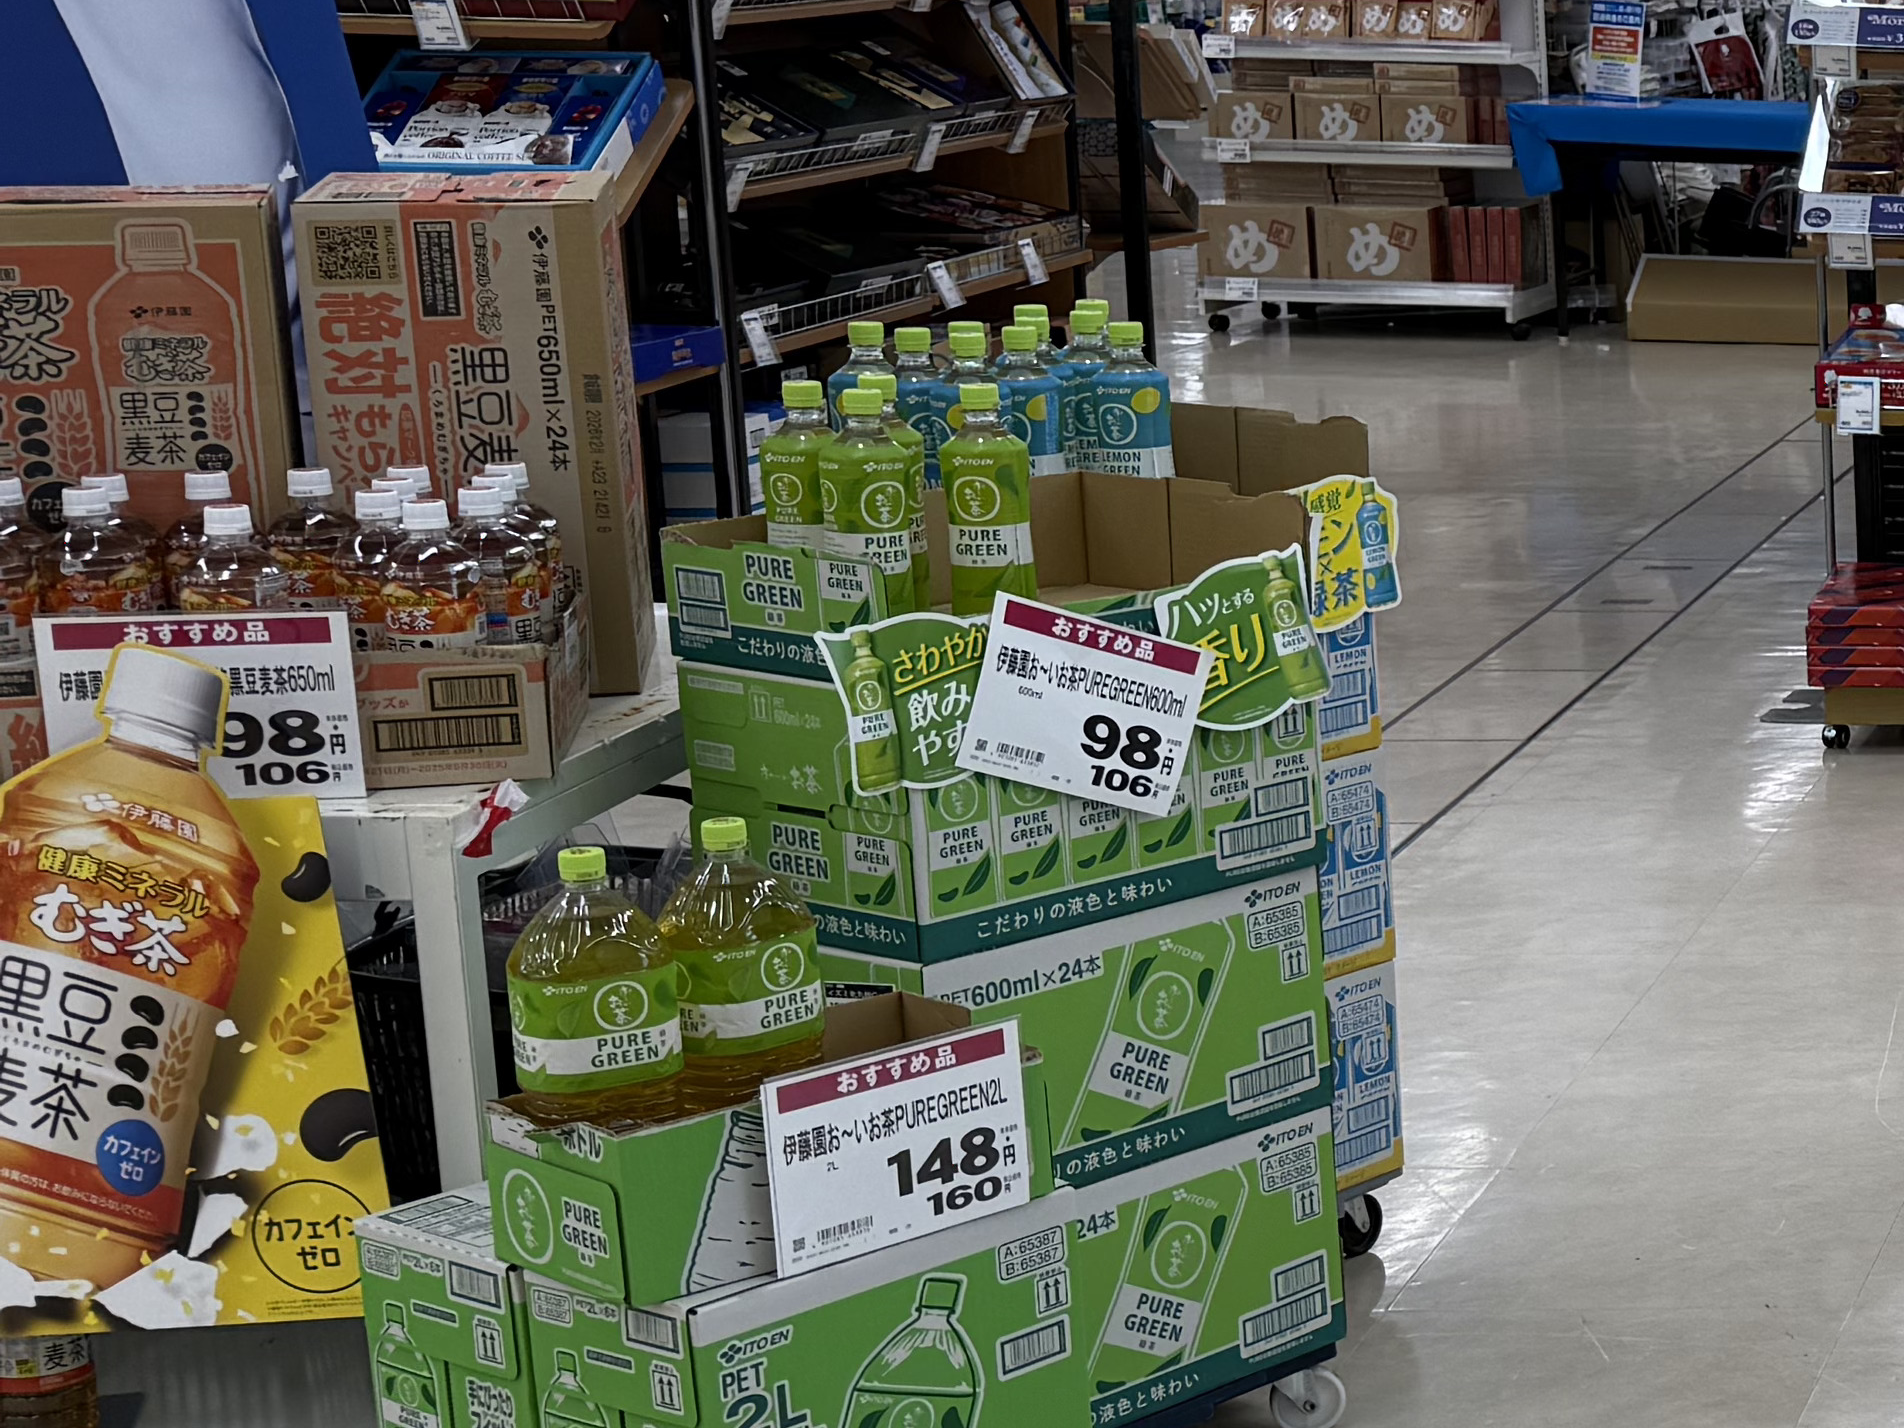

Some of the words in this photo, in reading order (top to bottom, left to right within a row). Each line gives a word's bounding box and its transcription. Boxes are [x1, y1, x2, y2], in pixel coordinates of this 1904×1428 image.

[1231, 103, 1270, 140] め
[1319, 103, 1359, 141] め
[1404, 105, 1444, 143] め
[1225, 221, 1279, 273] め
[1346, 223, 1399, 276] め
[120, 392, 183, 425] 黒豆
[124, 434, 186, 466] 麦茶
[1102, 451, 1141, 462] LEMON
[1171, 588, 1254, 638] ハッとする
[123, 621, 271, 645] おすすめ品
[1052, 617, 1154, 661] おすすめ品
[1335, 649, 1366, 664] LEMON
[908, 681, 971, 730] 飲み
[1081, 715, 1161, 769] 98
[234, 760, 331, 786] 106
[1090, 765, 1153, 797] 106
[1210, 779, 1248, 797] GREEN
[1213, 768, 1244, 784] PURE
[123, 800, 197, 843] 伊藤園
[36, 844, 210, 918] 健康ミネラル
[977, 875, 1173, 939] こだわりの液色と味わい
[1252, 905, 1299, 931] A:65385
[29, 884, 190, 975] むぎ茶
[1252, 923, 1300, 947] B:65385
[761, 1004, 814, 1029] GREEN
[765, 990, 809, 1013] PURE
[592, 1046, 659, 1068] GREEN
[597, 1031, 652, 1052] PURE
[837, 1045, 958, 1096] おすすめ品
[103, 1135, 162, 1166] カフェイン
[887, 1126, 999, 1197] 148
[1264, 1147, 1311, 1172] A:65385
[118, 1162, 144, 1182] ゼロ
[1266, 1165, 1313, 1191] B:65385
[927, 1175, 1001, 1216] 160
[563, 1200, 600, 1228] PURE
[563, 1225, 608, 1256] GREEN
[1003, 1231, 1058, 1258] A:65387
[296, 1246, 341, 1271] ゼロ
[1005, 1248, 1059, 1275] B:65387
[43, 1339, 85, 1371] 麦茶
[721, 1363, 763, 1398] PET
